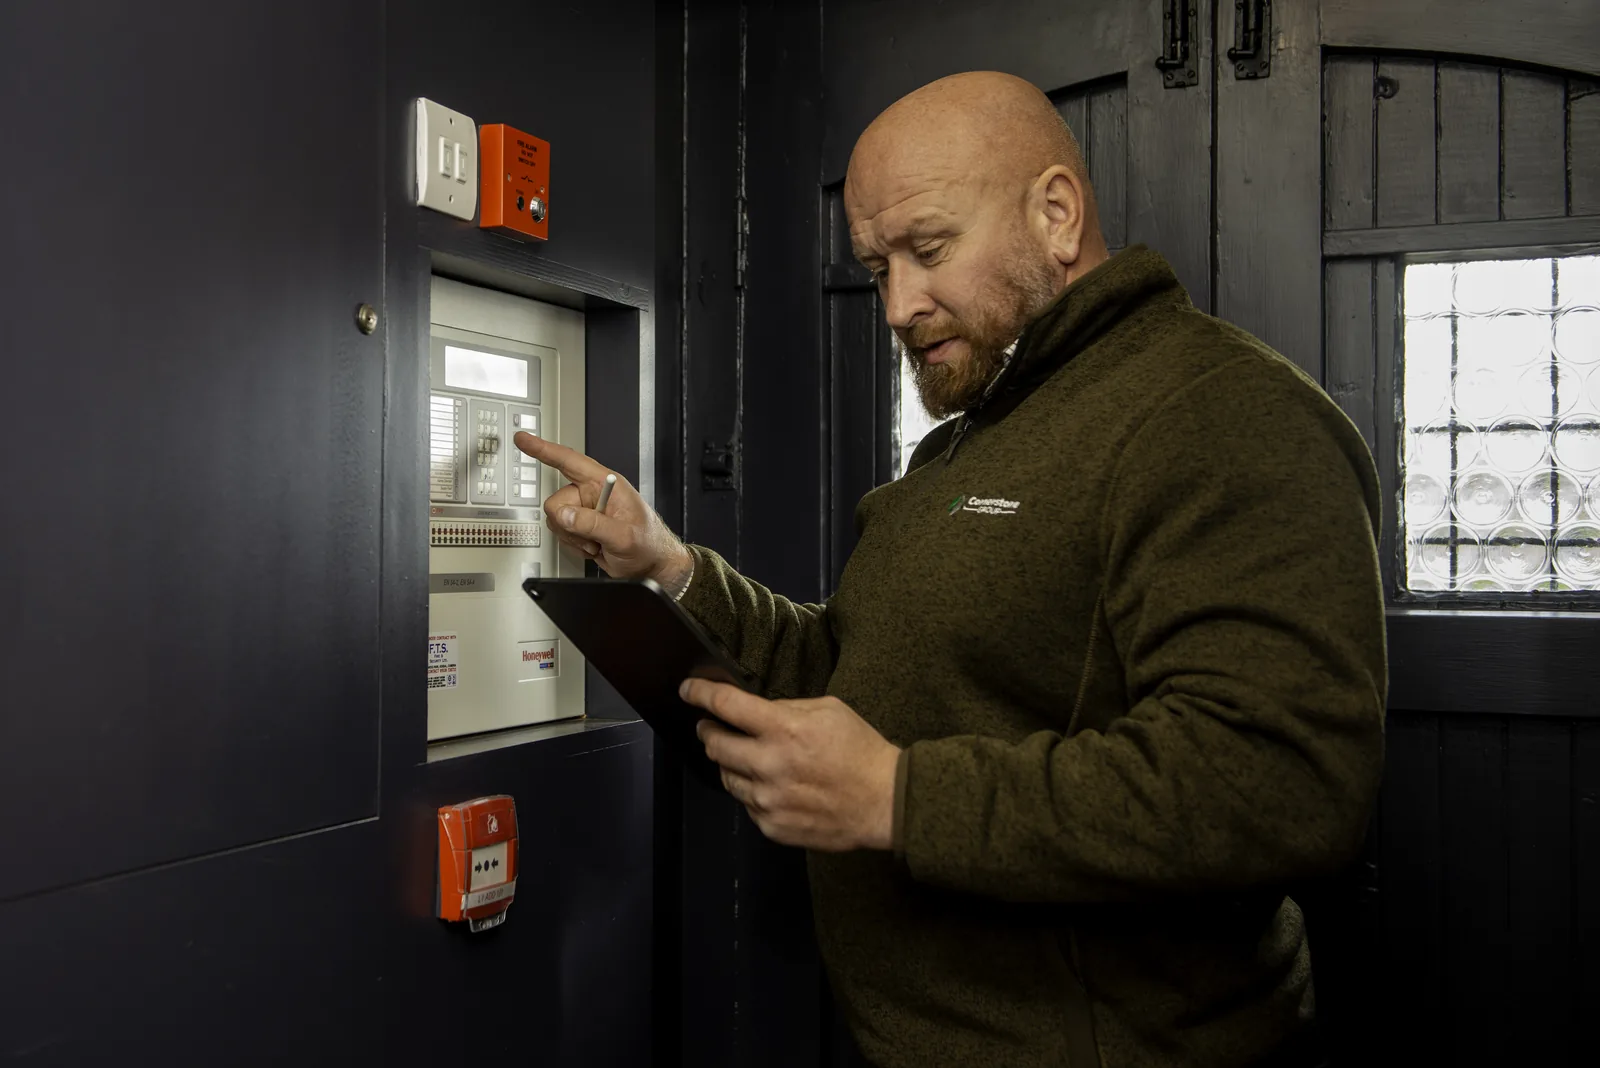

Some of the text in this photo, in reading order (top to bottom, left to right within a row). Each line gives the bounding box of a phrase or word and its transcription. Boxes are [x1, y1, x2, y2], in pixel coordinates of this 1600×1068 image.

[968, 496, 1020, 508] Cornerstone
[977, 506, 1002, 515] GROUP
[429, 642, 449, 654] F.T.S.
[522, 648, 554, 662] Honeywell
[484, 890, 496, 901] ADD
